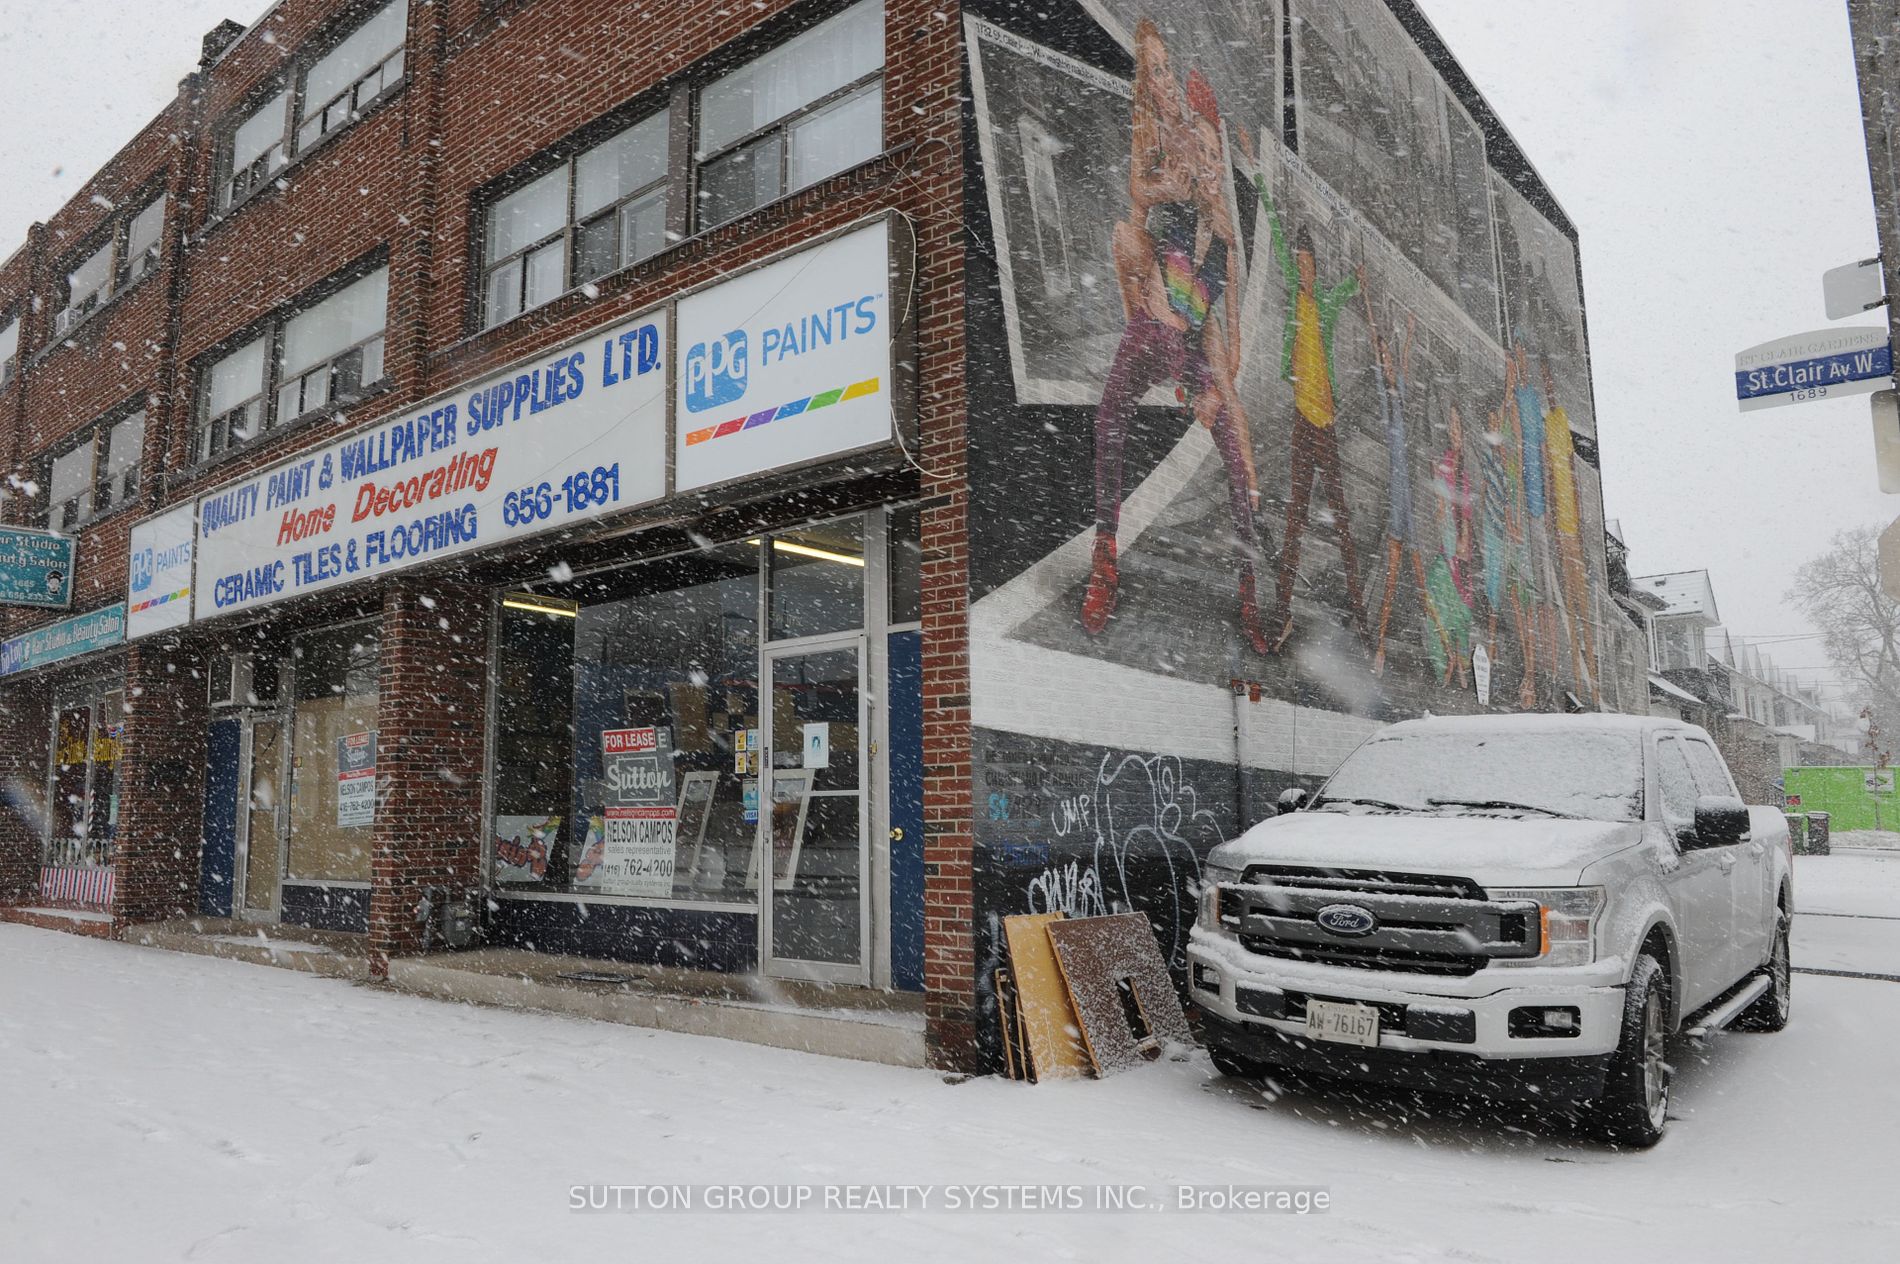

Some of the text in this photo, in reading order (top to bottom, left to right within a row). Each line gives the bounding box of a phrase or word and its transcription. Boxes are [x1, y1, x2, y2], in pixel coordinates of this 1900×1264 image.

[687, 295, 876, 400] PPG PAINTS
[1774, 361, 1824, 388] Clair
[1830, 362, 1850, 378] Av
[1854, 352, 1874, 374] W
[1790, 387, 1827, 402] 1689
[202, 323, 661, 538] QUALITY PAINT & WALLPAPER SUPPLIES LTD.
[276, 447, 498, 547] Home Decorating
[16, 535, 60, 550] Studio
[214, 462, 620, 608] CERAMIC TILES & FLOORING 656-1881
[30, 555, 67, 569] Salon
[156, 541, 190, 573] PAINTS
[73, 618, 99, 643] Beauty
[99, 613, 119, 636] Salon
[605, 734, 623, 748] FOR
[625, 732, 655, 747] LEASE
[607, 764, 672, 791] Sutton
[607, 820, 673, 844] NELSON CAMPOS
[623, 858, 673, 877] 762-4200
[1329, 912, 1360, 929] Ford
